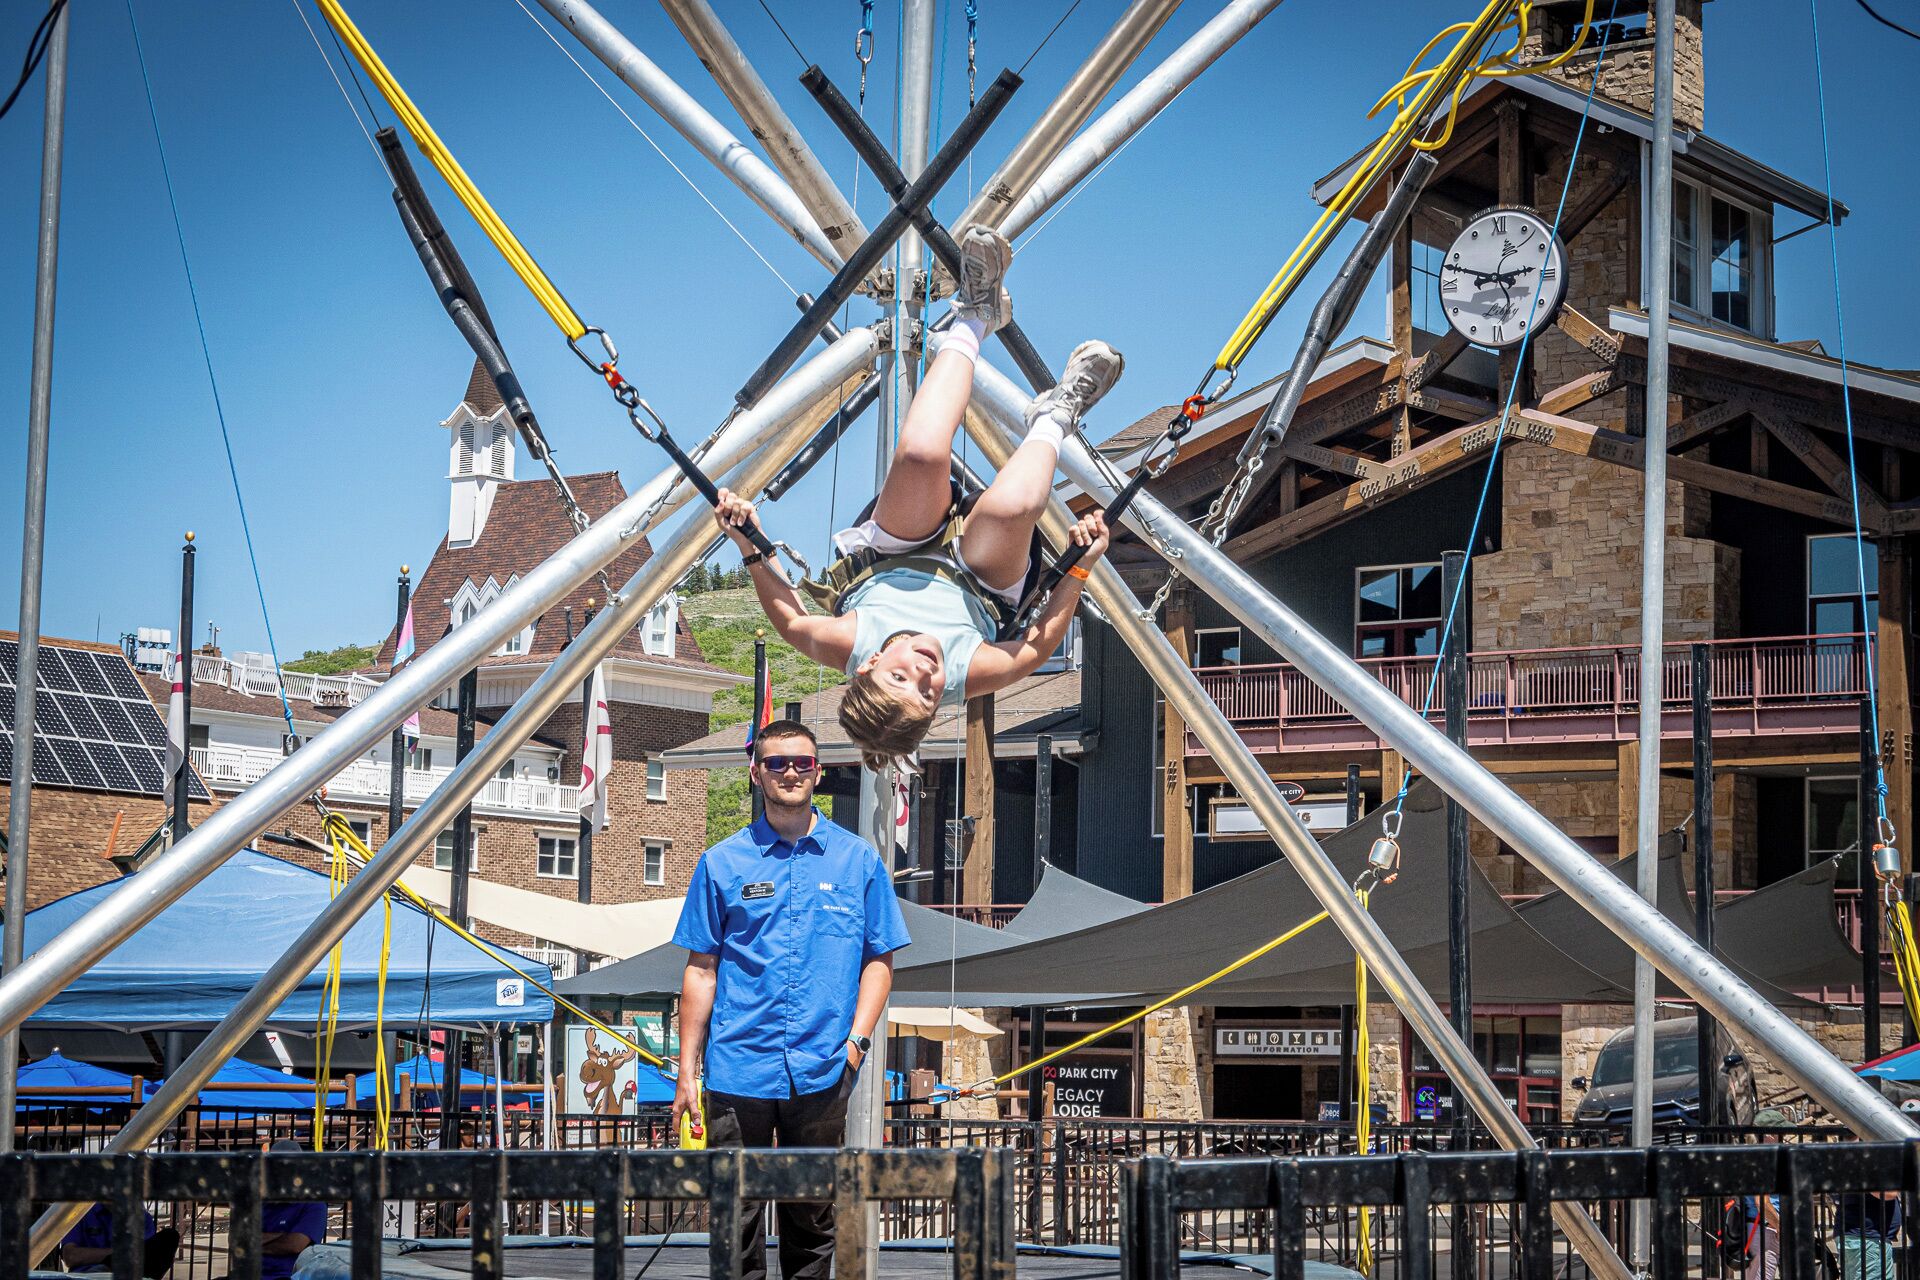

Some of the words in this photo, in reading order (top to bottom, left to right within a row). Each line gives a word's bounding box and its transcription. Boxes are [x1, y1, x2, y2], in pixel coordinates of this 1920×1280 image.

[1059, 1067, 1088, 1079] PARK
[1090, 1068, 1118, 1080] CITY
[1052, 1104, 1101, 1118] LODGE
[1325, 1109, 1340, 1119] peps
